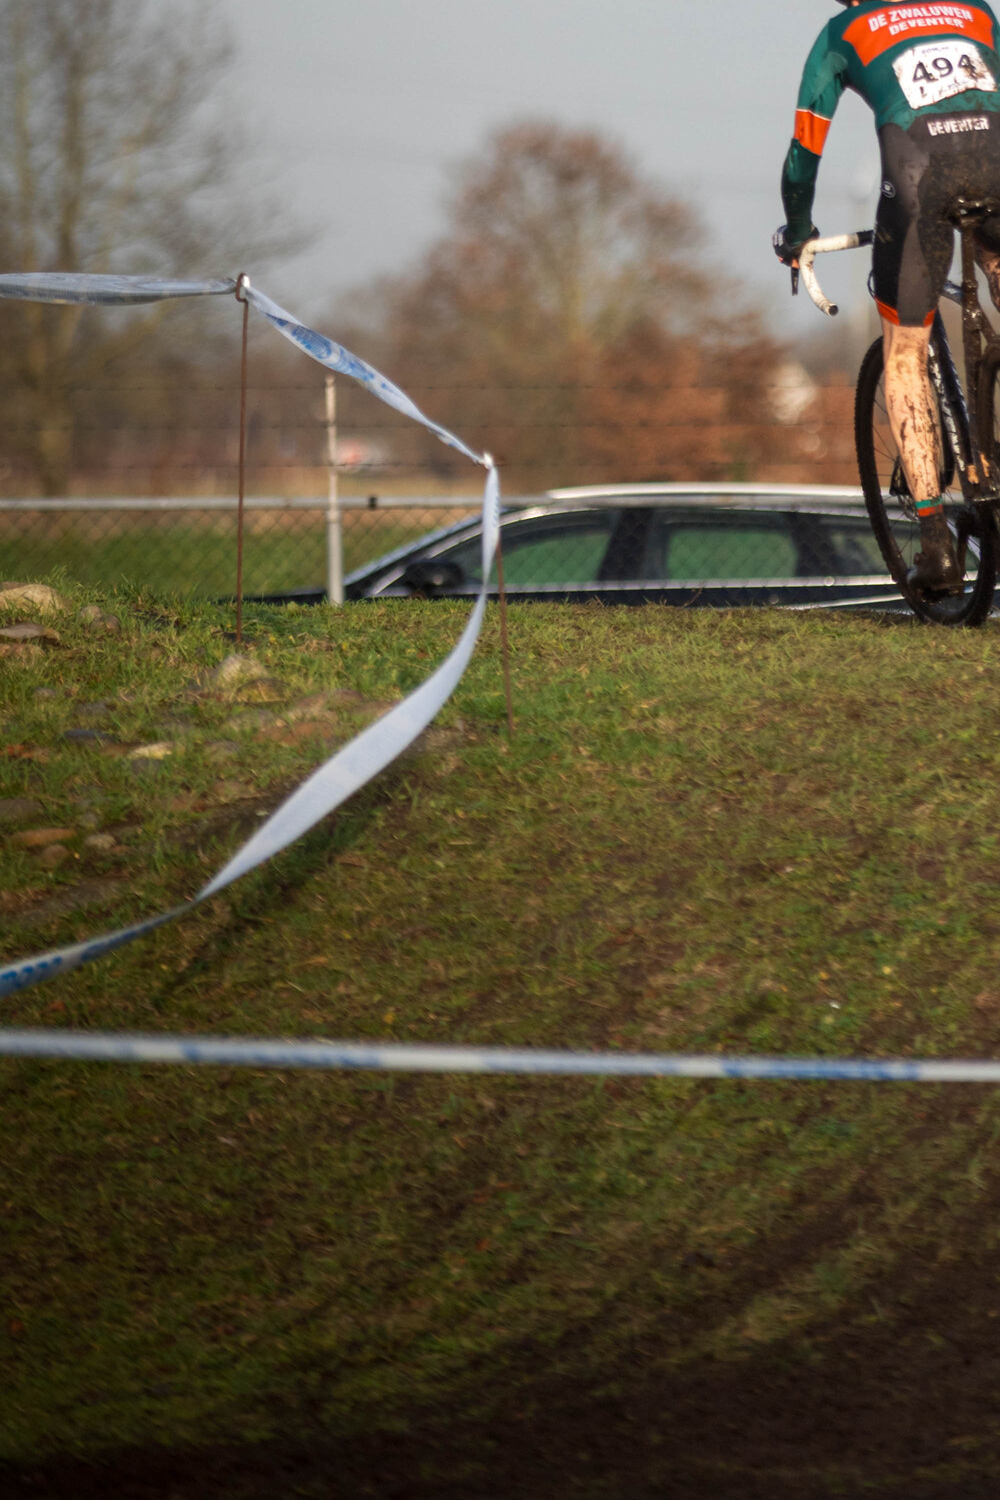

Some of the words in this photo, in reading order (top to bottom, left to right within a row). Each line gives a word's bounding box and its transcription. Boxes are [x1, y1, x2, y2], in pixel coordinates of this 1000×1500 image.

[868, 13, 888, 32] DE
[888, 5, 974, 22] ZWALUWEN
[888, 17, 964, 36] DEVENTER
[912, 54, 978, 83] 494
[927, 117, 990, 137] DEVENTER
